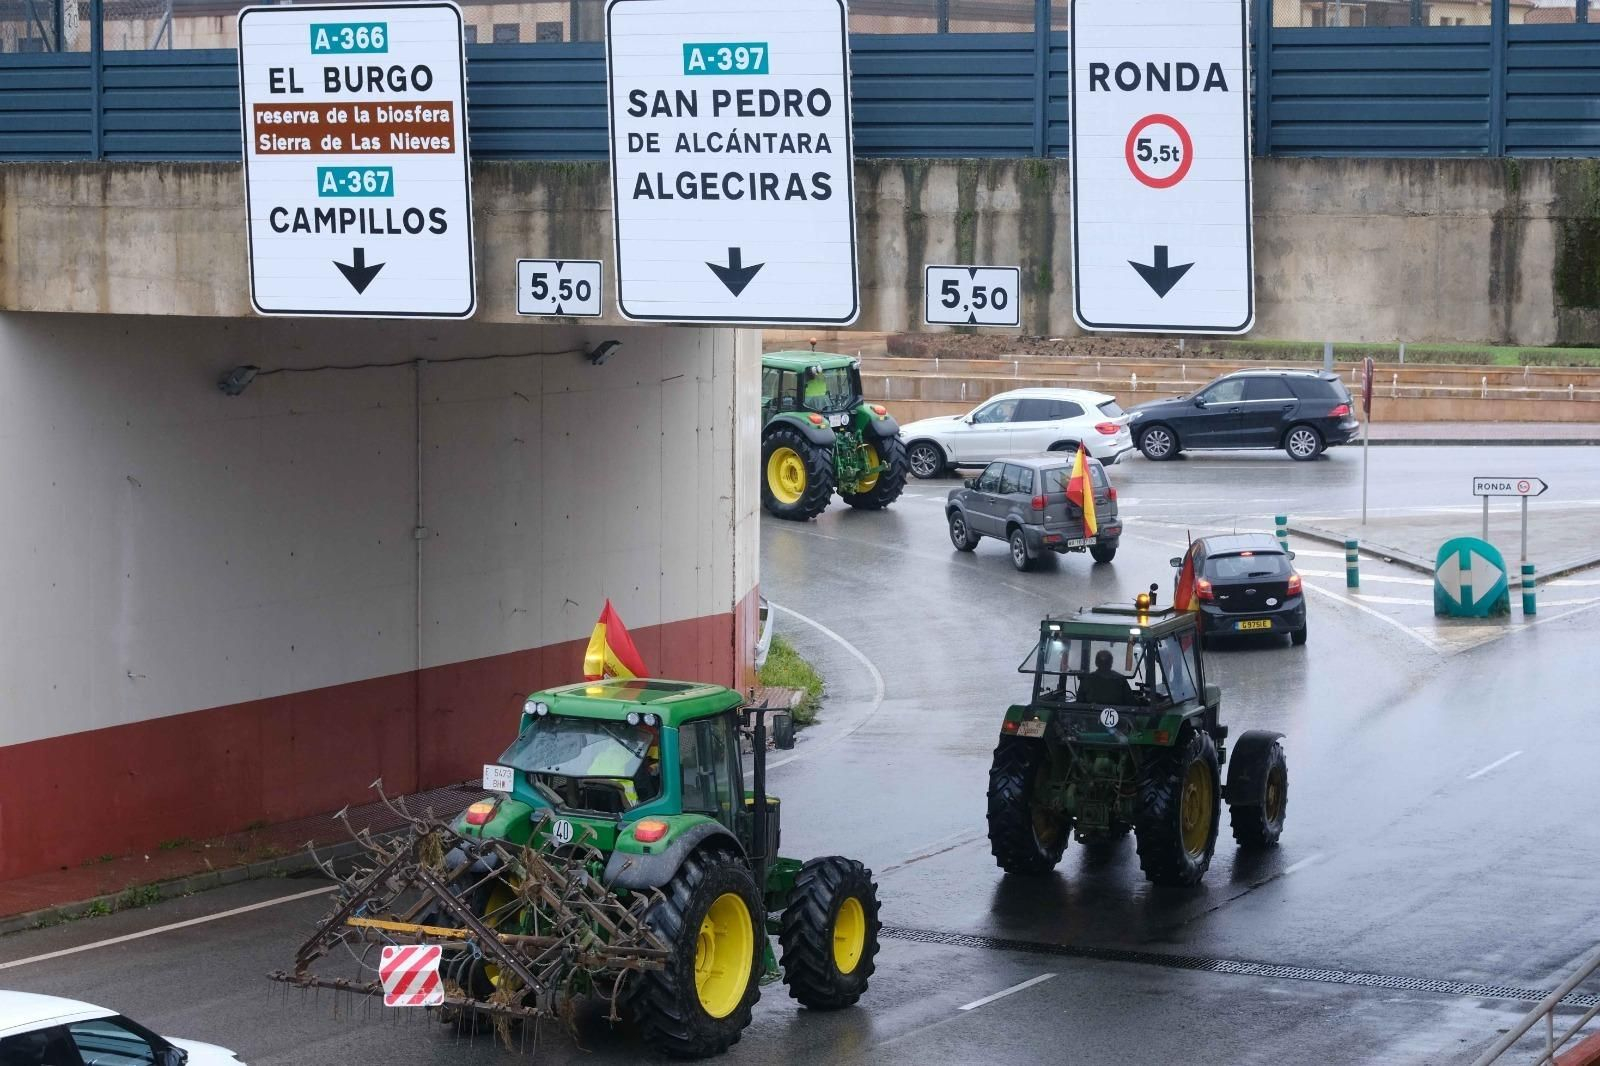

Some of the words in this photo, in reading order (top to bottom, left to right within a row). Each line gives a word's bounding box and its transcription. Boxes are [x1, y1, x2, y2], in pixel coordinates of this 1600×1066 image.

[316, 27, 384, 49] A-366
[689, 47, 763, 70] A-397
[269, 68, 303, 93] EL
[324, 65, 432, 92] BURGO
[1090, 62, 1228, 91] RONDA
[257, 111, 319, 124] reserva
[327, 108, 347, 123] de
[354, 106, 370, 123] la
[377, 105, 450, 123] biosfera
[627, 89, 697, 117] SAN
[713, 88, 831, 117] PEDRO
[260, 134, 311, 150] Sierra
[321, 134, 342, 150] de
[351, 133, 380, 150] Las
[390, 133, 450, 149] Nieves
[628, 133, 660, 152] DE
[675, 128, 832, 153] ALCÁNTARA
[1136, 138, 1180, 164] 5,5t
[323, 171, 389, 192] A-367
[633, 171, 832, 200] ALGECIRAS
[270, 207, 447, 234] CAMPILLOS
[531, 273, 591, 304] 5,50
[941, 279, 1008, 312] 5,50
[1477, 483, 1512, 491] RONDA
[1104, 710, 1115, 726] 25
[556, 821, 569, 840] 40
